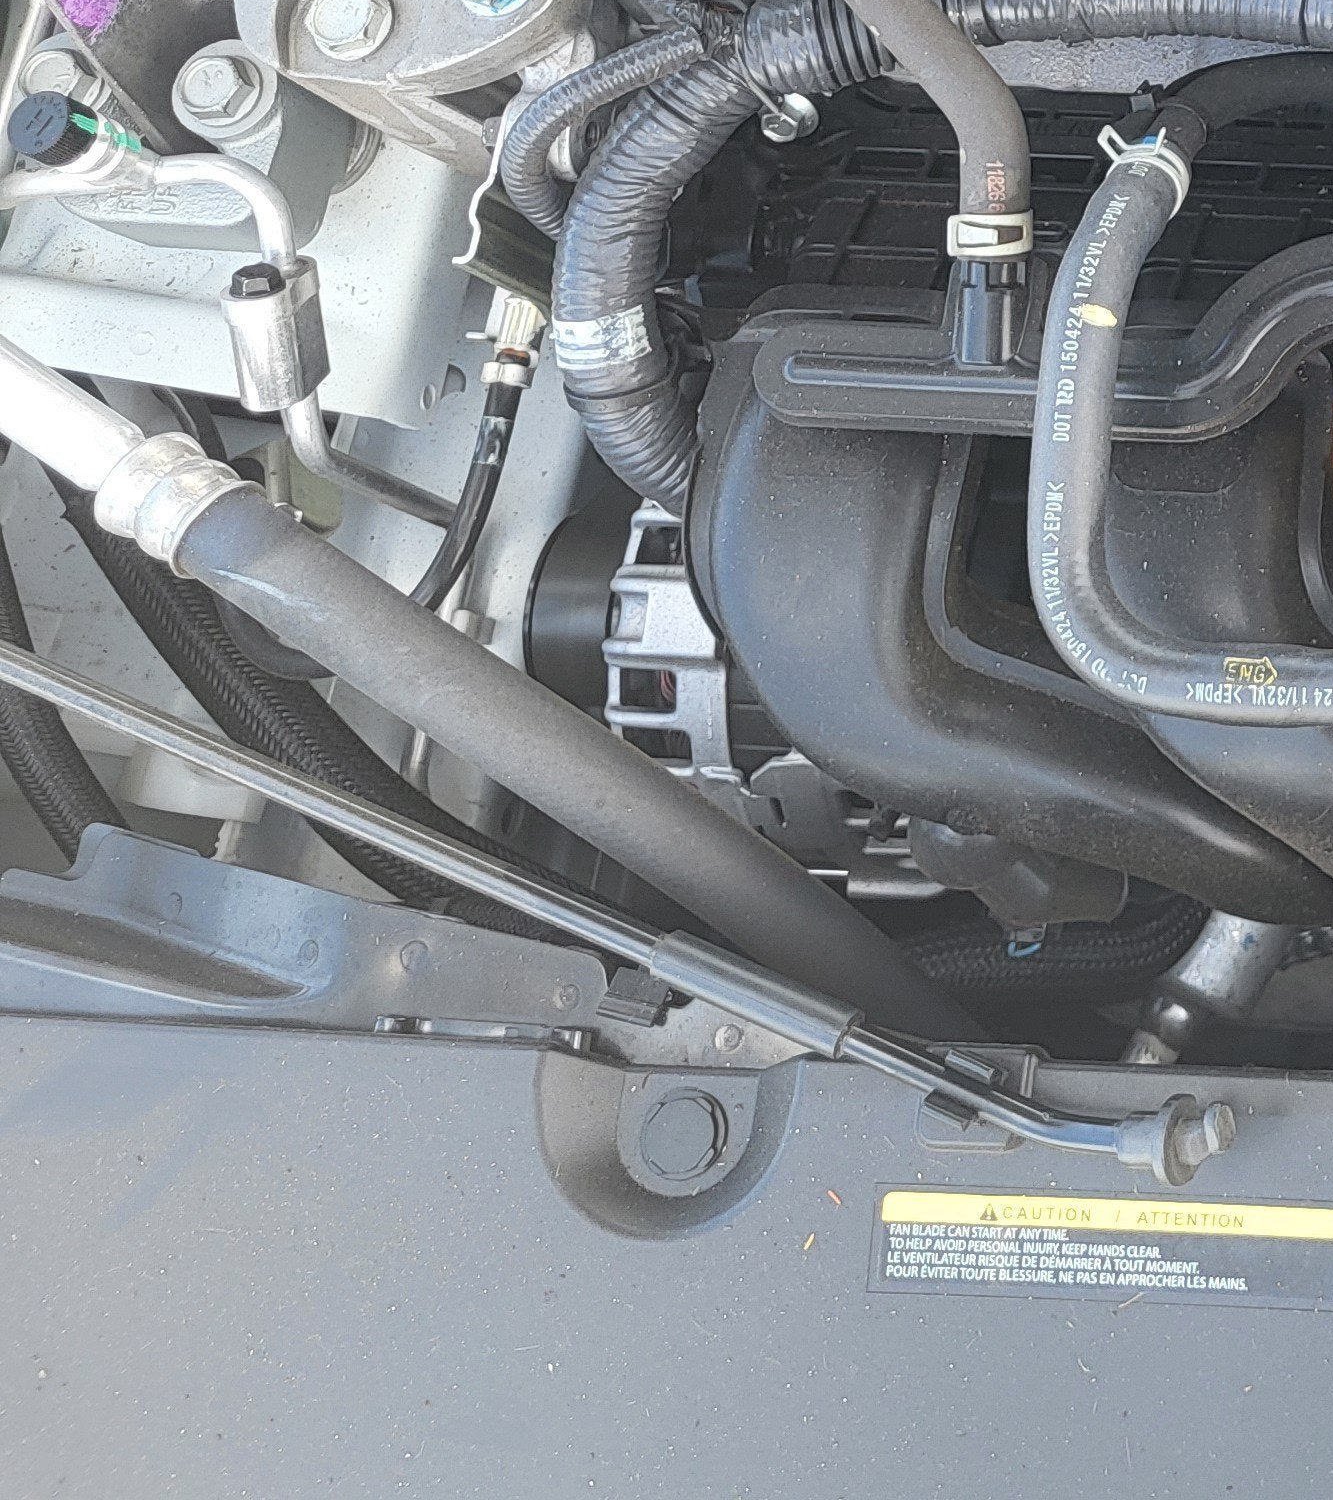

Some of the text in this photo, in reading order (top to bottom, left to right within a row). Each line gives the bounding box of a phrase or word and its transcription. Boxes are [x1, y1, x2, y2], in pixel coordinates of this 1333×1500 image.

[1071, 238, 1108, 300] 11/32VL
[1060, 305, 1088, 372] 150424
[1052, 411, 1073, 442] DOT
[1224, 663, 1268, 684] ENG
[1184, 682, 1243, 706] >EPDM<
[1247, 684, 1308, 706] 11/32VL
[1002, 1206, 1092, 1223] CAUTION
[1137, 1212, 1245, 1229] ATTENTION
[890, 1224, 1070, 1242] FAN BLADE CAN START AT ANY TIME.
[891, 1237, 1161, 1259] TO HELP AVOID PERSONAL INJURY, KEEP HANDS CLEAR.
[888, 1251, 1200, 1275] LE VENTILATEUR RISQUE DE DÉMARRER À TOUT MOMENT.
[886, 1264, 1249, 1290] POUR ÉVITER TOUTE BLESSURE, NE PAS EN APPROCHER LES MAINS.
